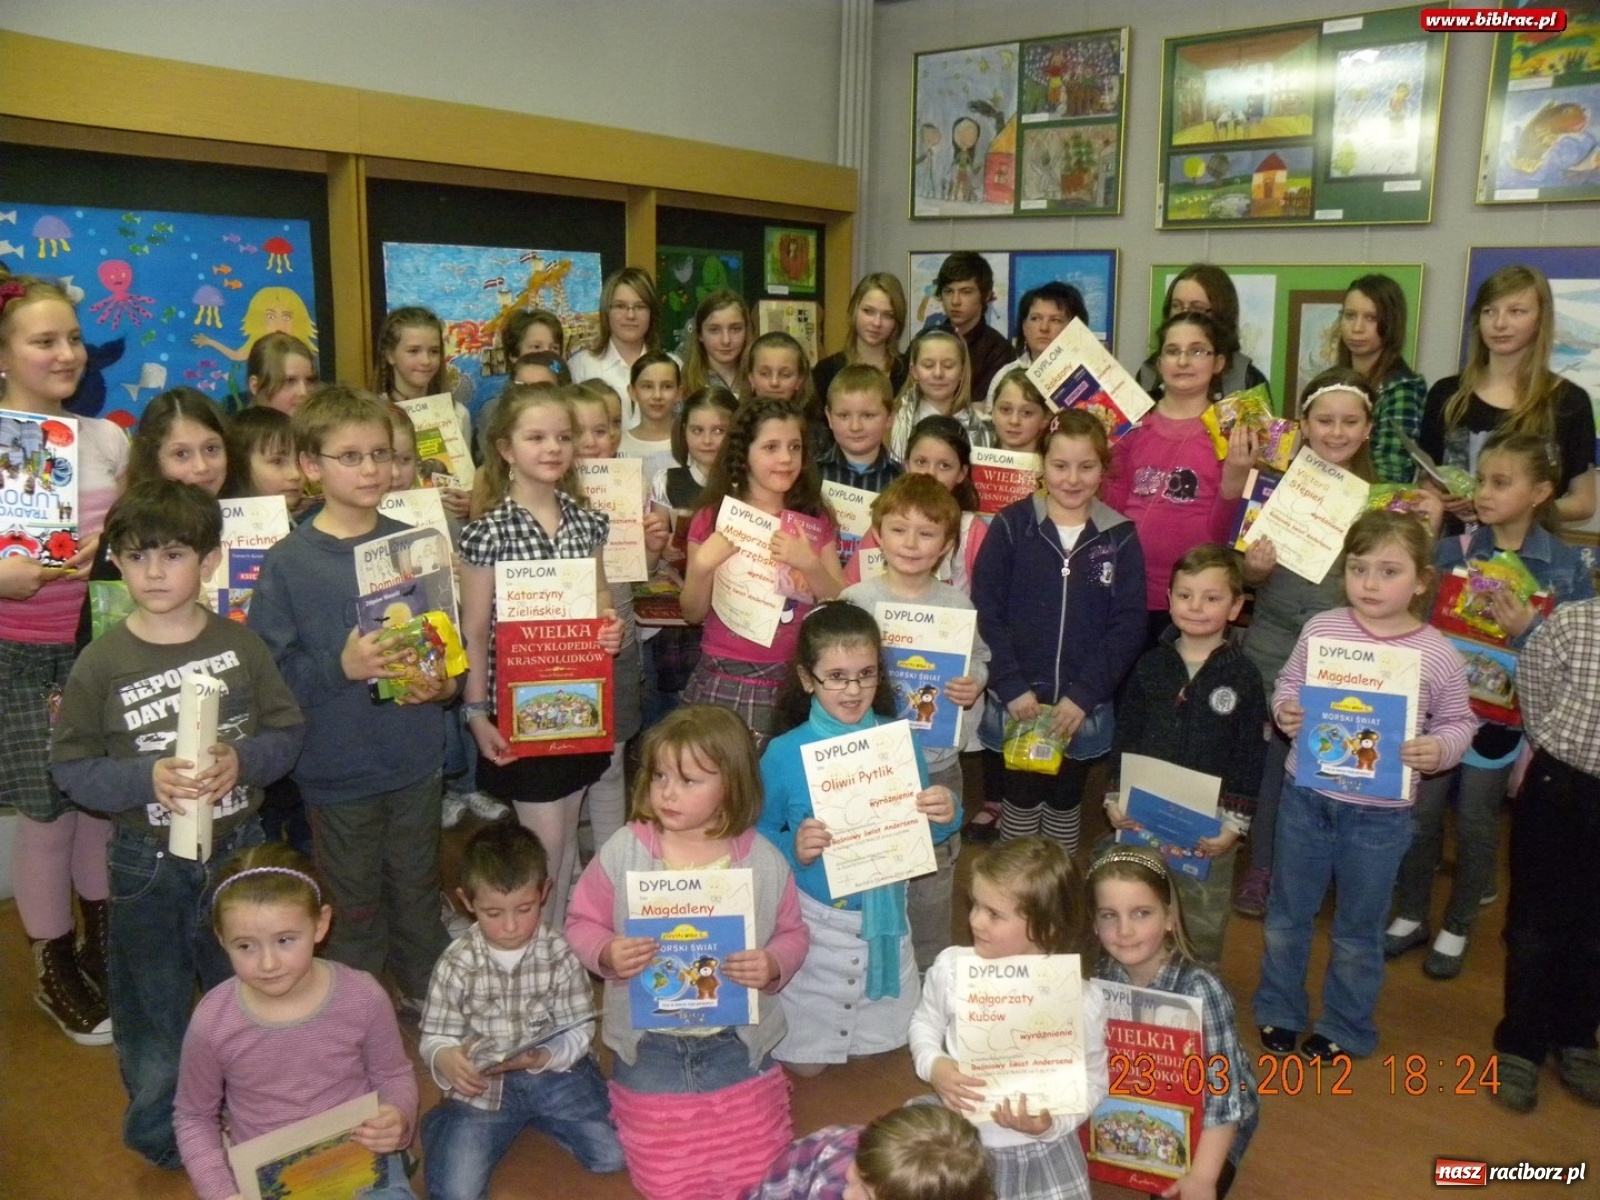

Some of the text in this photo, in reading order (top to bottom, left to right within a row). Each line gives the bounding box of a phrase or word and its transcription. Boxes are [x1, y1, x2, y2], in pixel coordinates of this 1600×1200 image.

[1033, 345, 1064, 379] DYPLOM
[407, 403, 428, 414] PLOM
[976, 452, 1014, 465] DYPLOM
[575, 465, 609, 475] YPLOM
[1305, 454, 1345, 482] DYPLOM
[0, 489, 60, 509] LUDO
[828, 487, 864, 504] DYPLOM
[730, 505, 772, 531] DYPLOM
[723, 525, 772, 551] Małgorza
[364, 541, 411, 563] DYPLOM
[506, 567, 557, 579] DYPLOM
[507, 588, 564, 601] Katarzyny
[507, 604, 567, 618] Zielińskiej
[884, 609, 935, 623] DYPLOM
[520, 623, 592, 639] WIELKA
[882, 630, 914, 644] Igora
[511, 641, 601, 654] ENCYKLOPEDIA
[1319, 644, 1375, 663] DYPLOM
[507, 652, 605, 667] KRASNOLUDKÓW
[1317, 668, 1384, 690] Magdaleny
[1321, 711, 1382, 726] MORSKI ŚWIAT
[814, 738, 870, 763] DYPLOM
[858, 764, 894, 785] Pytlik
[639, 879, 702, 893] DYPLOM
[641, 903, 715, 919] Magdaleny
[660, 943, 718, 953] ORSKI ŚWIAT
[968, 964, 1030, 979] DYPLOM
[967, 992, 1035, 1007] Małgorzaty
[968, 1011, 1006, 1023] Kubów
[1019, 1029, 1073, 1042] wyróżnienie
